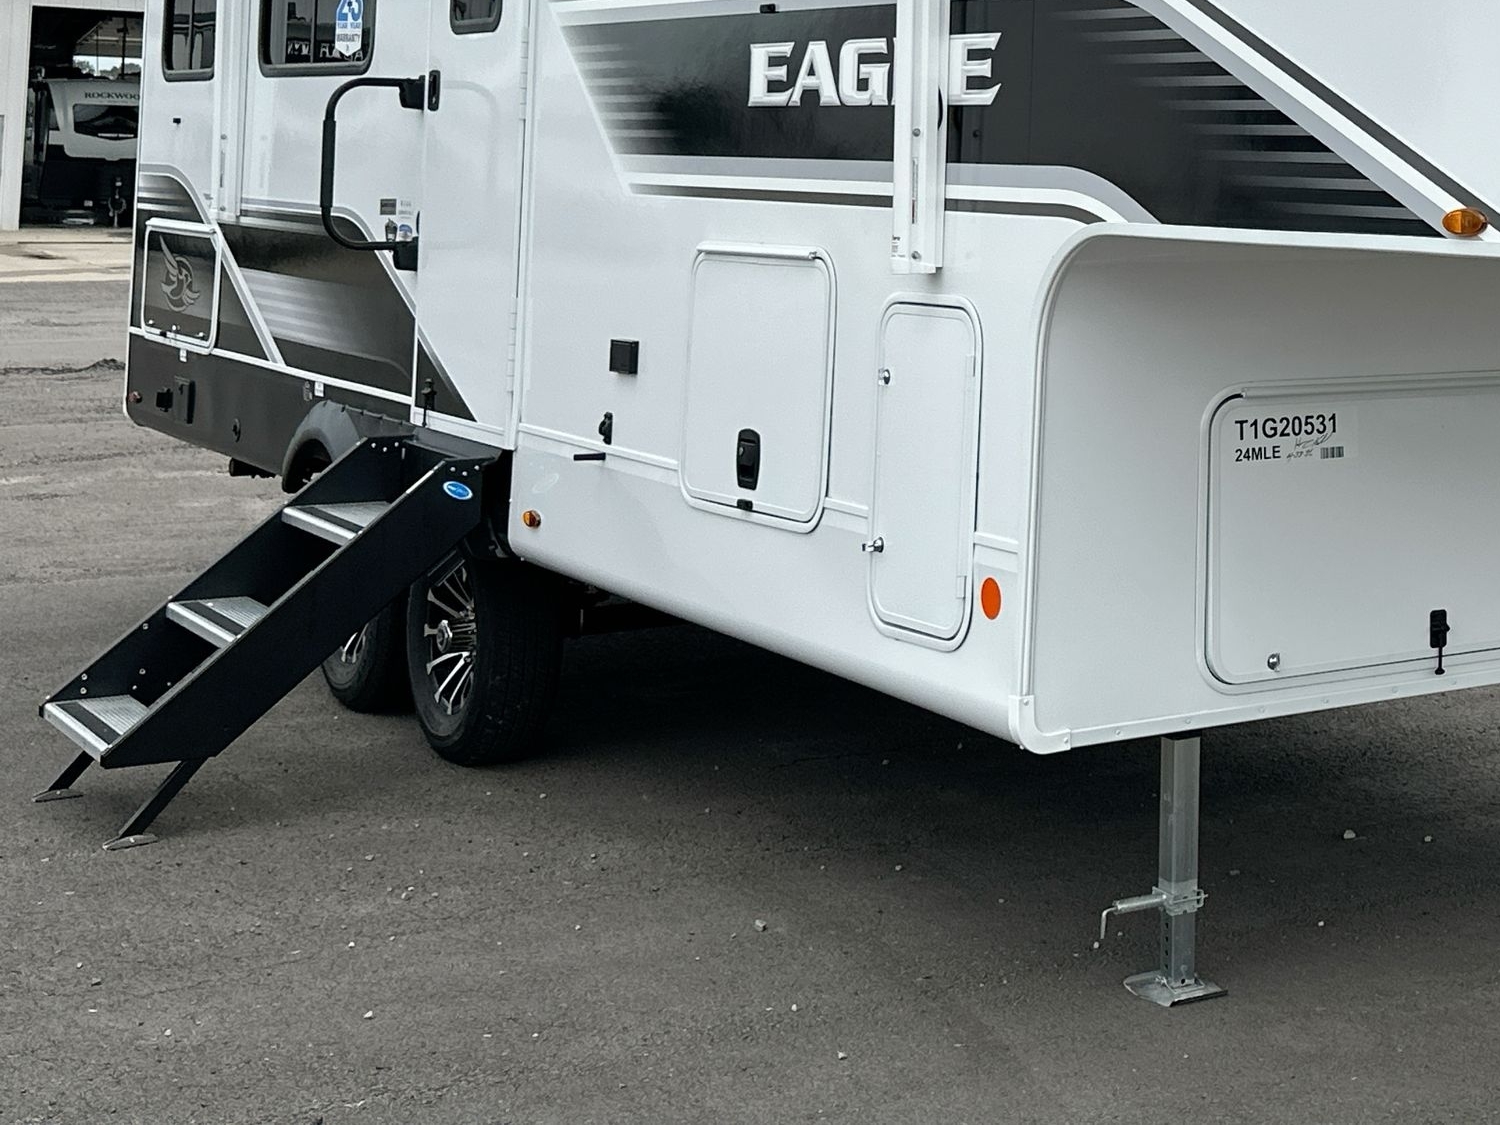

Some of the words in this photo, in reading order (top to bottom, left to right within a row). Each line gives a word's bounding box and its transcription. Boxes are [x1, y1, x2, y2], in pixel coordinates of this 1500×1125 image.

[748, 32, 1001, 107] EAGE
[1234, 413, 1336, 441] T1G20531
[1234, 445, 1281, 462] 24MLE
